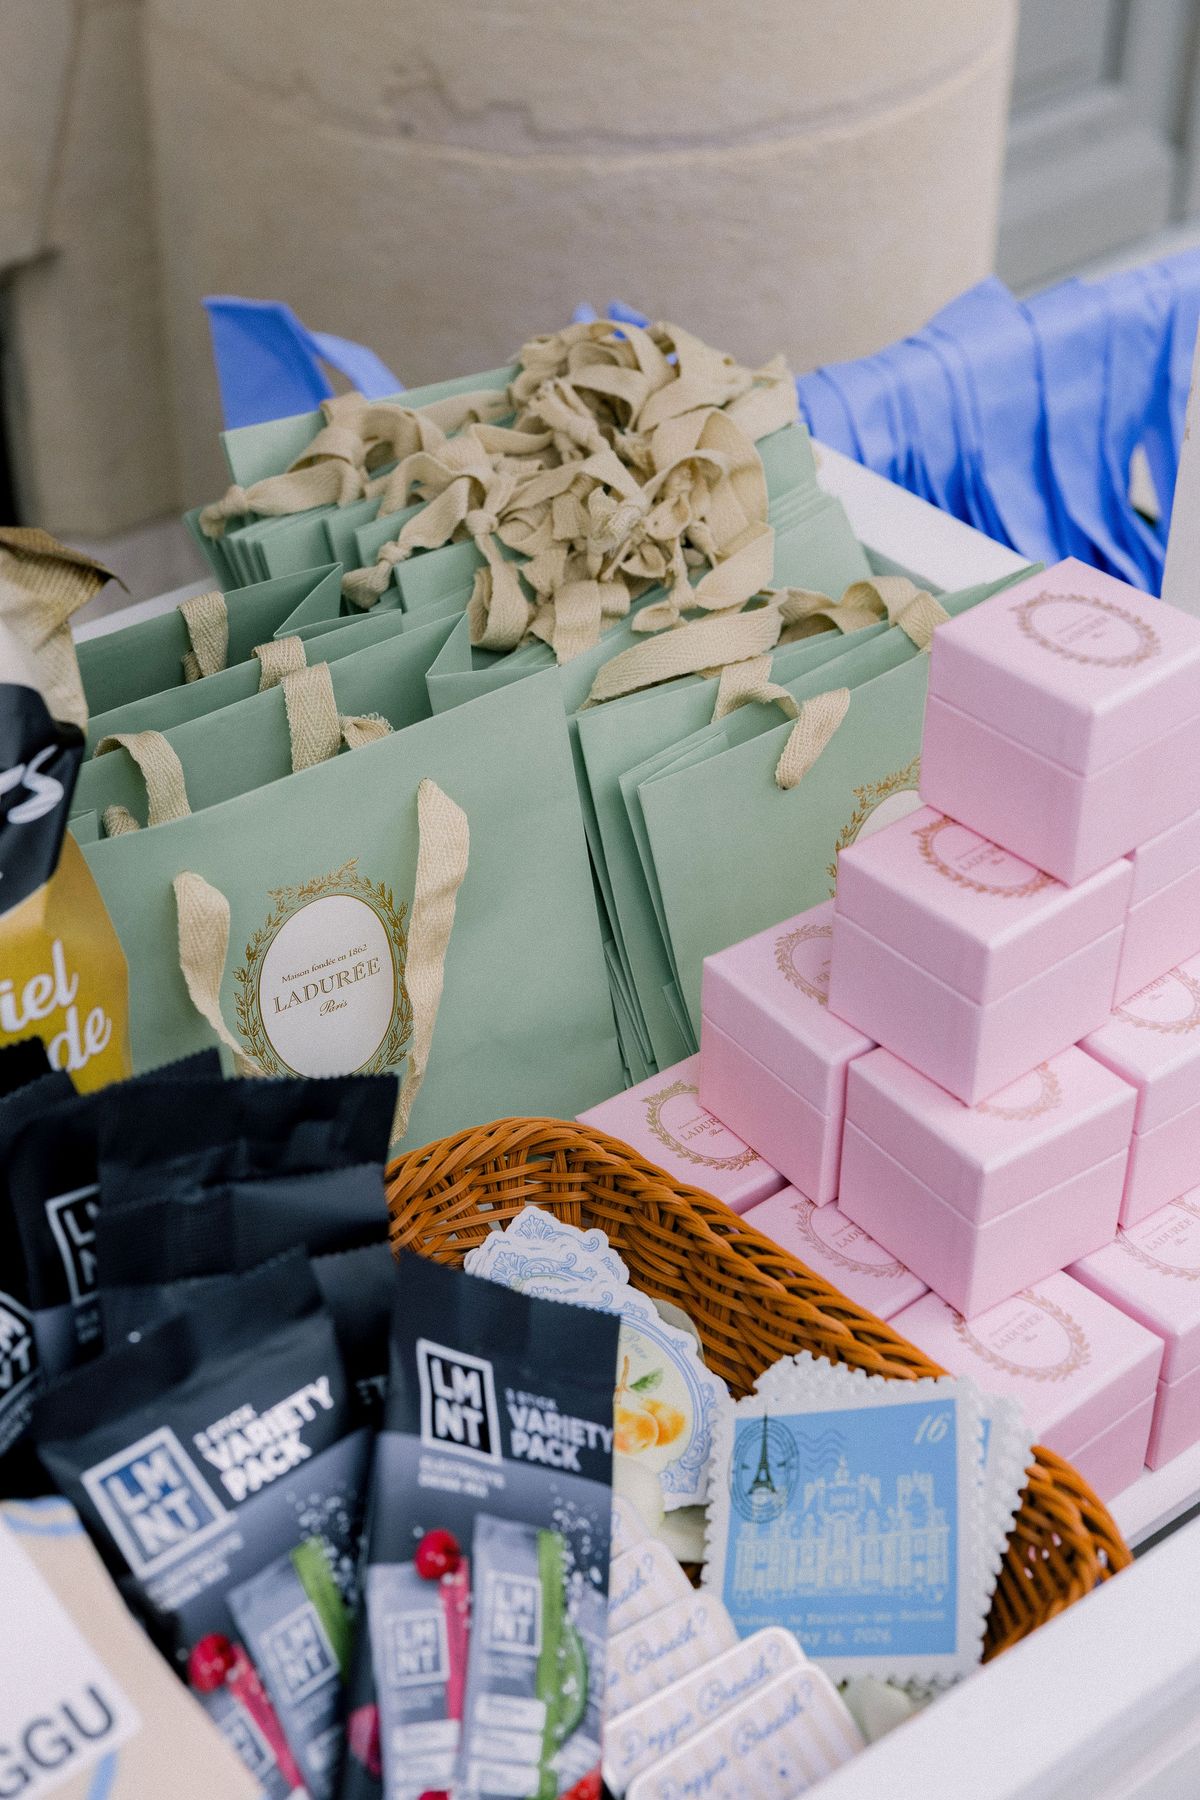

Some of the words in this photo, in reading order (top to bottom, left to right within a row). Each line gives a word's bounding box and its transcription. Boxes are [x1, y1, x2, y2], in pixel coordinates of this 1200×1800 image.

[272, 957, 381, 1014] LADURÉE
[281, 969, 310, 983] Maison
[311, 959, 336, 973] fondée
[337, 954, 347, 962] en
[348, 943, 368, 958] 1862
[319, 999, 348, 1017] Paris
[201, 1375, 334, 1470] VARIETY
[506, 1403, 613, 1454] VARIETY
[913, 1412, 950, 1445] 16
[219, 1433, 312, 1501] PACK
[510, 1429, 582, 1472] PACK
